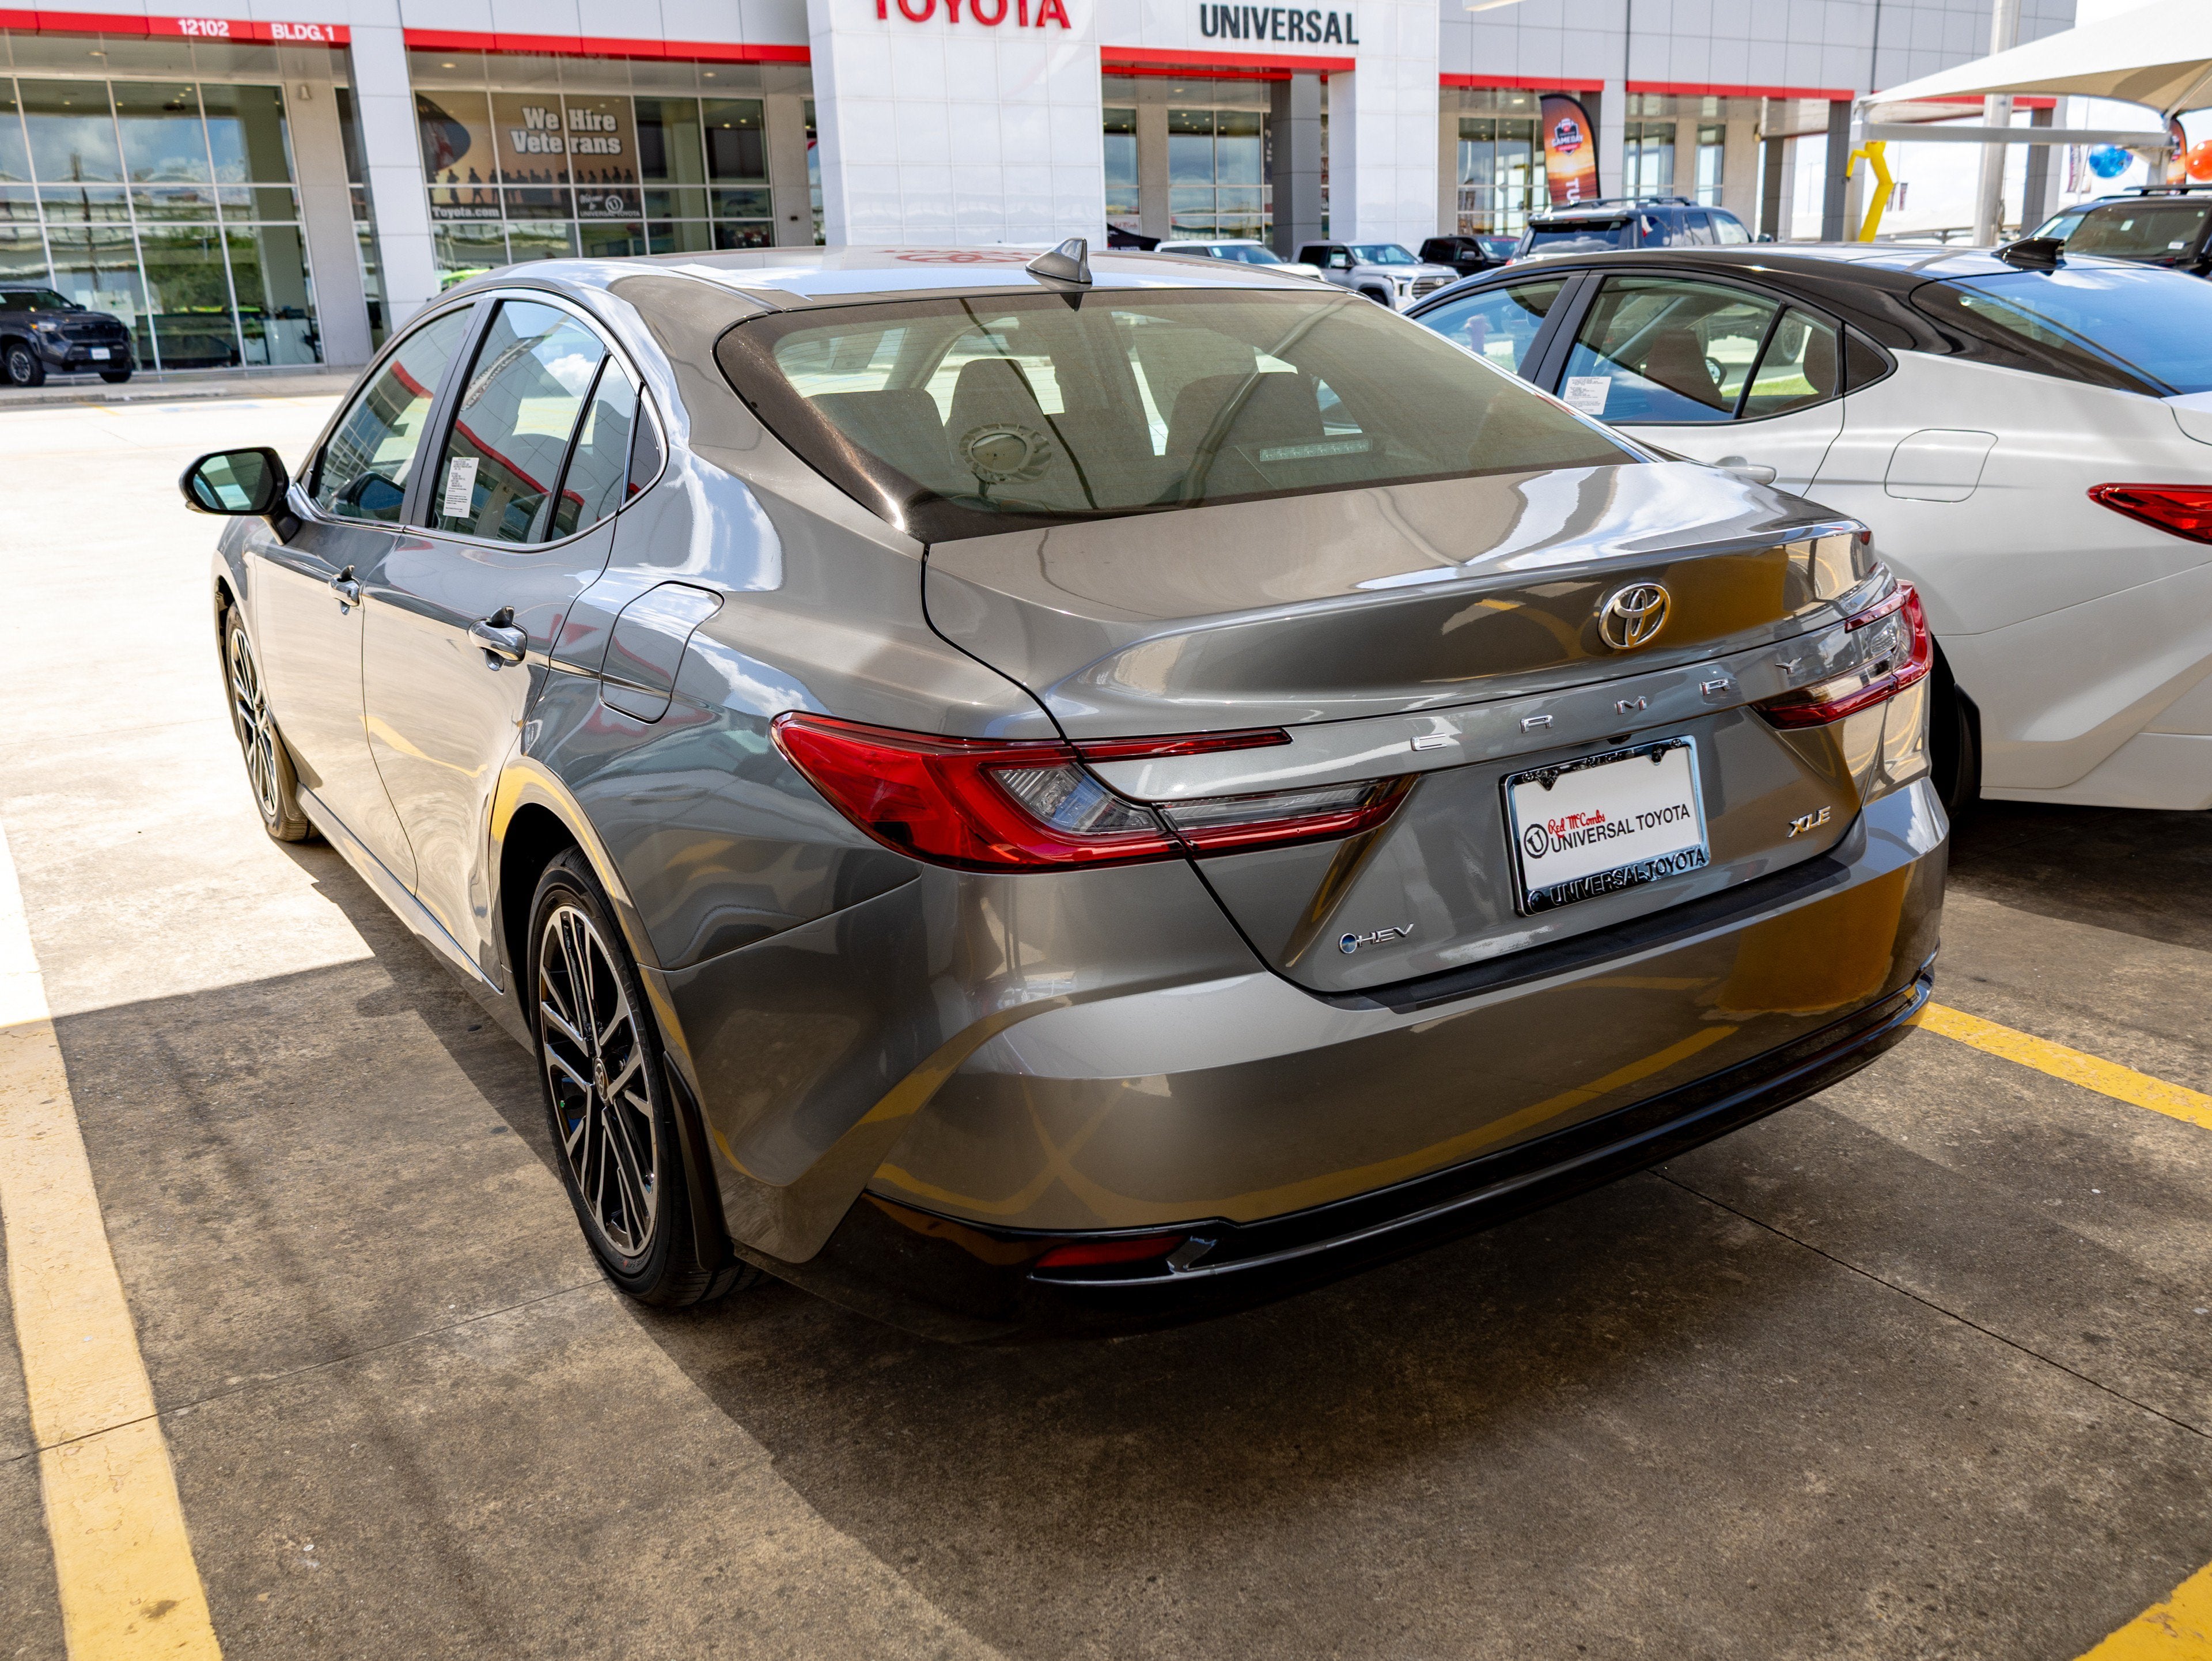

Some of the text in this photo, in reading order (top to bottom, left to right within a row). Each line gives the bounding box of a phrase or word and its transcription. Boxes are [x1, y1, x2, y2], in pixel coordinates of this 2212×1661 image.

[177, 18, 335, 41] 12102 BLDG. 1
[1200, 3, 1359, 45] UNIVERSAL
[522, 107, 618, 132] We Hire
[510, 130, 622, 154] Veterans
[433, 206, 500, 219] Toyota.com
[1411, 656, 1802, 752] CAMRY
[1547, 818, 1566, 838] Red
[1550, 803, 1691, 853] UNIVERSAL TOYOTA
[1787, 805, 1831, 838] XLE
[1549, 847, 1706, 906] UNIVERSAL TOYOTA
